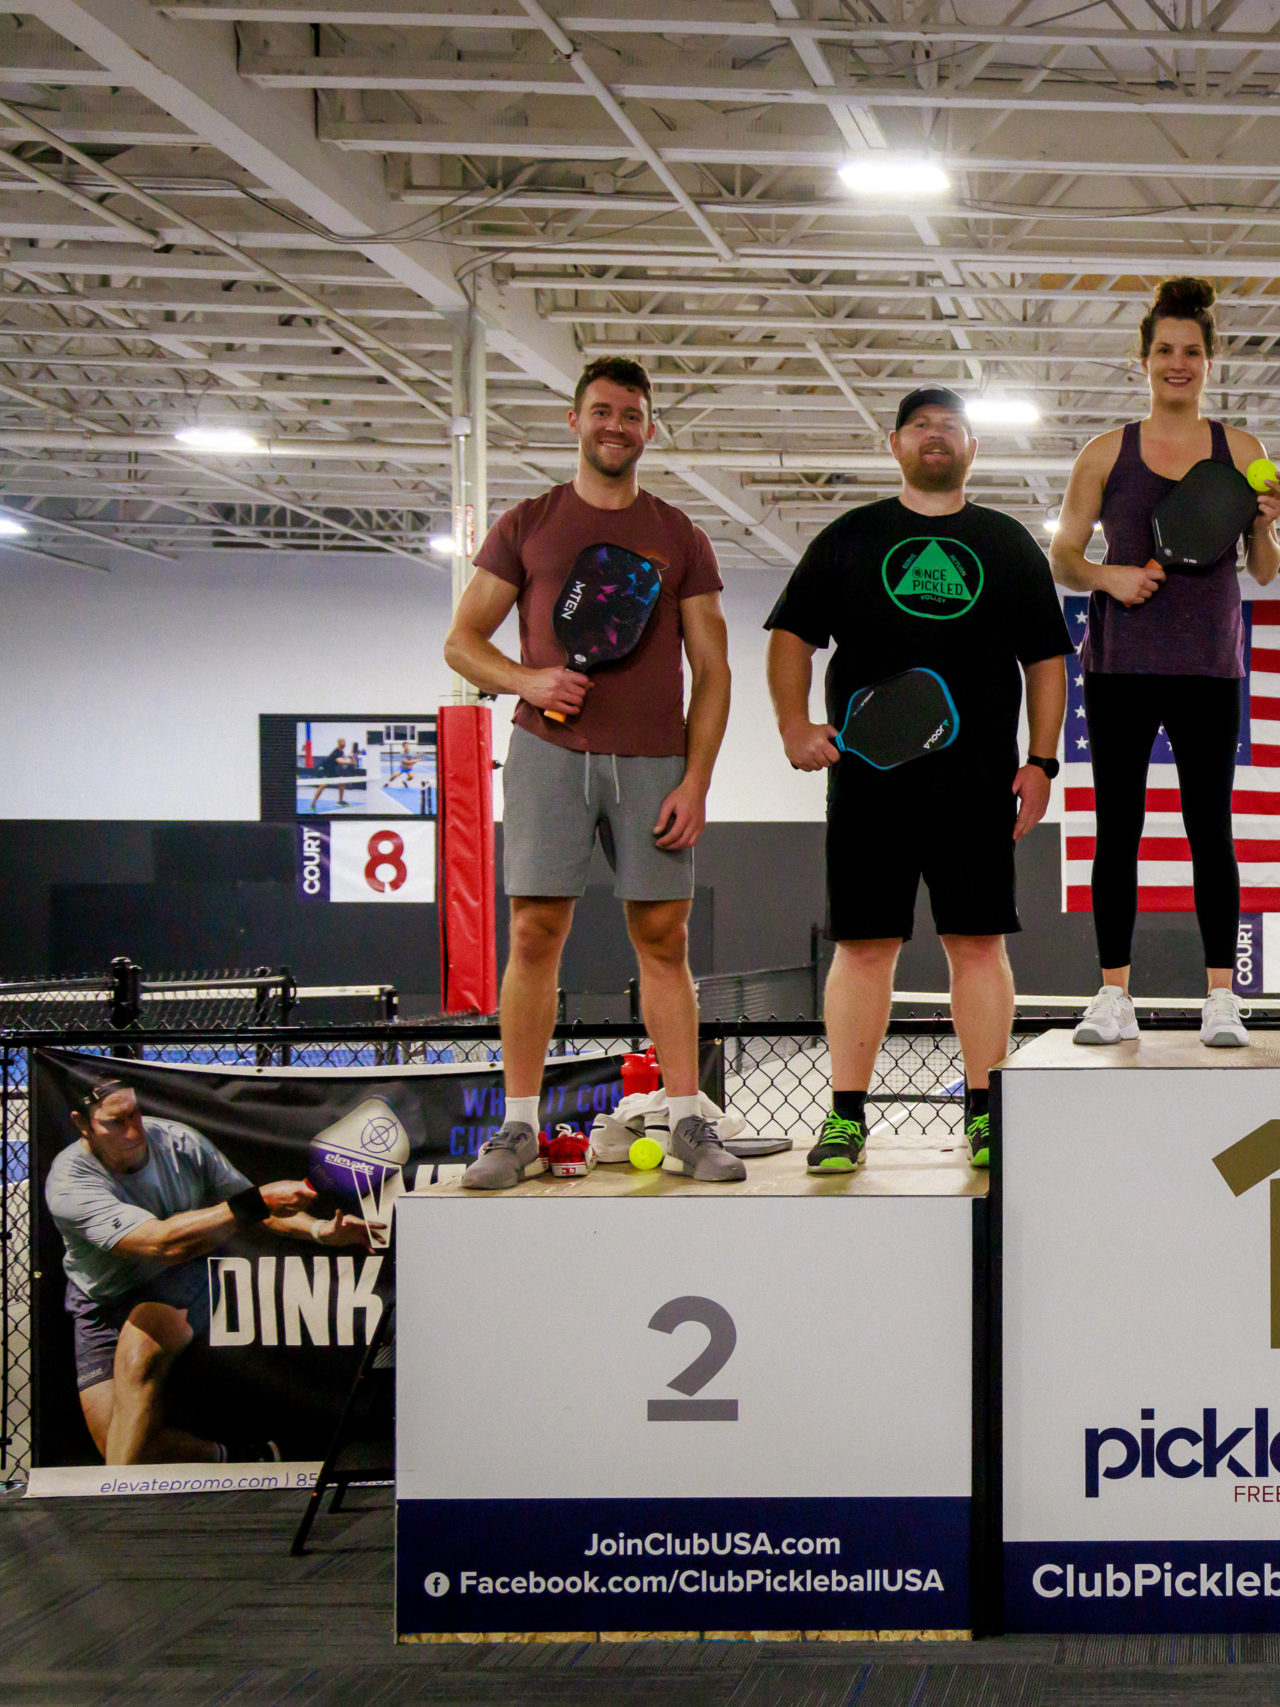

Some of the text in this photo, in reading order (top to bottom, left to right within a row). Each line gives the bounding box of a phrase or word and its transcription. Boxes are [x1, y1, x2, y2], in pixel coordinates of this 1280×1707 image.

[913, 579, 963, 596] PICKLED
[920, 594, 946, 604] VOLLEY
[923, 724, 944, 749] JOOLA
[303, 827, 321, 894] COURT
[365, 830, 407, 893] 8
[1236, 922, 1253, 985] COURT
[325, 1153, 374, 1175] elevate
[209, 1257, 384, 1346] DINK
[647, 1296, 738, 1421] 2
[100, 1475, 278, 1493] elevatepromo.com
[584, 1532, 841, 1557] JoinClubUSA.com
[459, 1568, 944, 1595] Facebook.com/ClubPickleballUSA
